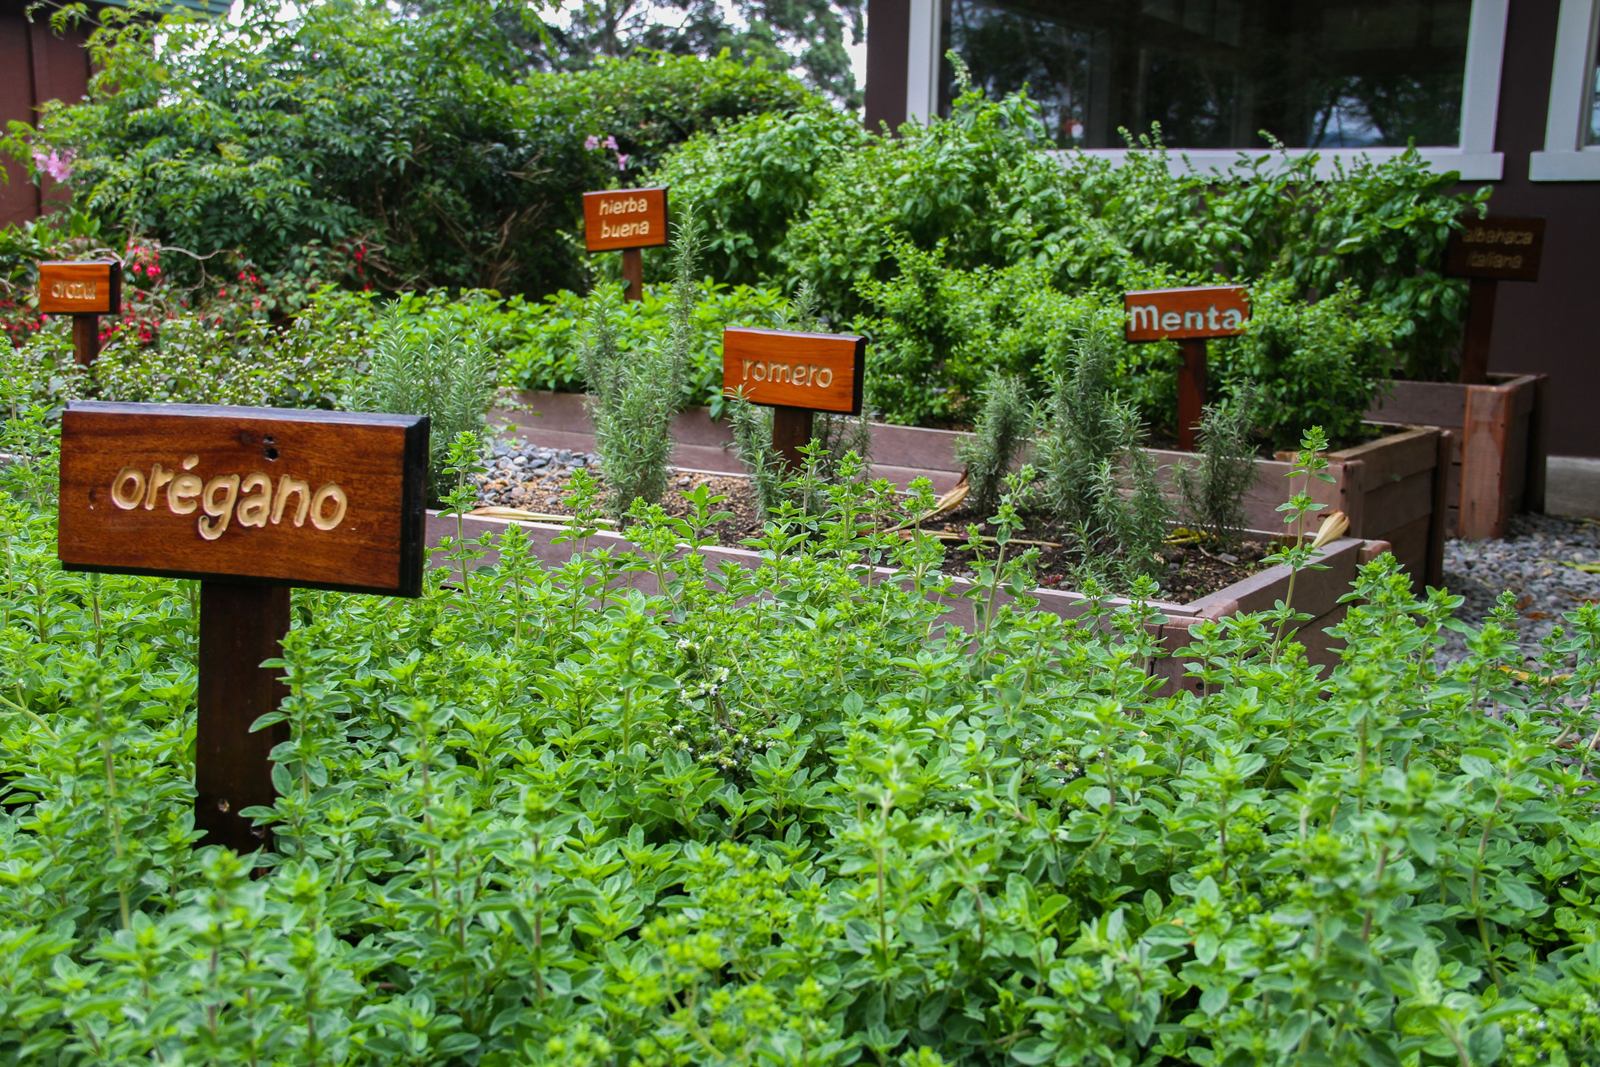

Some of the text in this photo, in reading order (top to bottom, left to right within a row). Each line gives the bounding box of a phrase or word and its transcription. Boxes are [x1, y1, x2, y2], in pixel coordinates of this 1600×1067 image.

[599, 197, 648, 216] hierba
[600, 220, 650, 239] buena
[742, 359, 833, 388] romero
[111, 454, 348, 541] orégano
